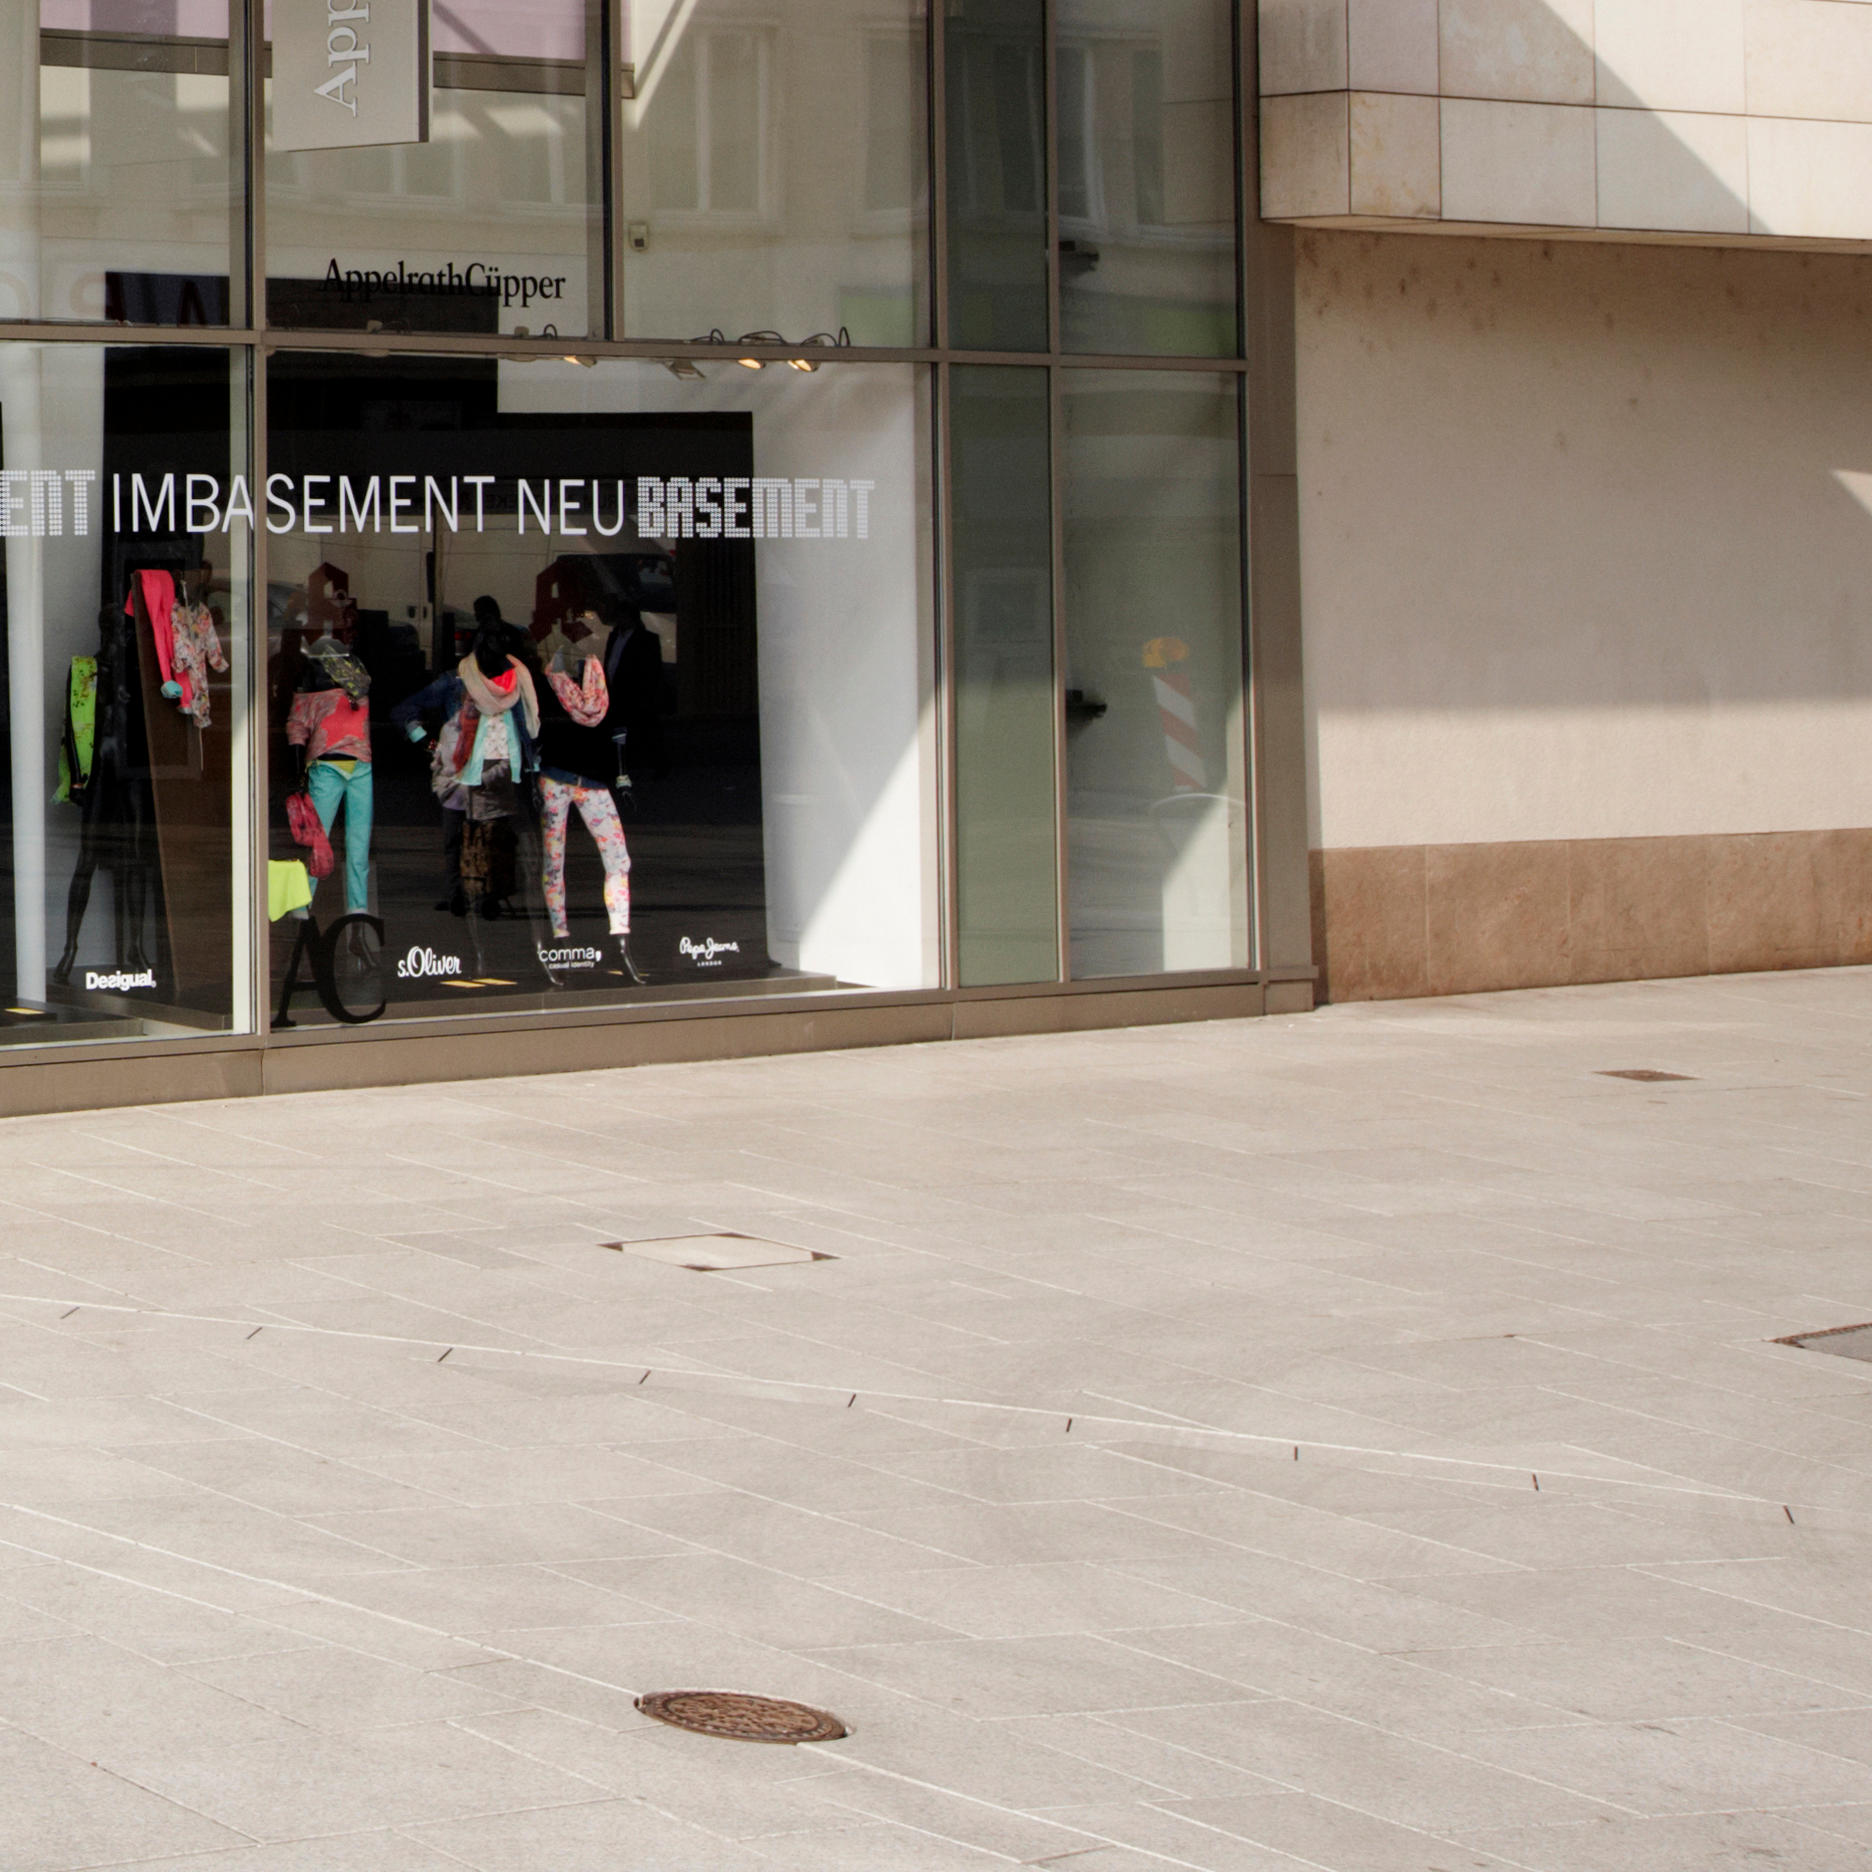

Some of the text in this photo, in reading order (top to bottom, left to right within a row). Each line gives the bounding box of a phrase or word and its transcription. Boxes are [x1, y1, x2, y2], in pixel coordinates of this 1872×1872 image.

[320, 258, 566, 309] AppelrathCüpper
[518, 479, 624, 536] NEU
[637, 476, 875, 539] BASEMENT
[397, 945, 462, 978] s.Oliver
